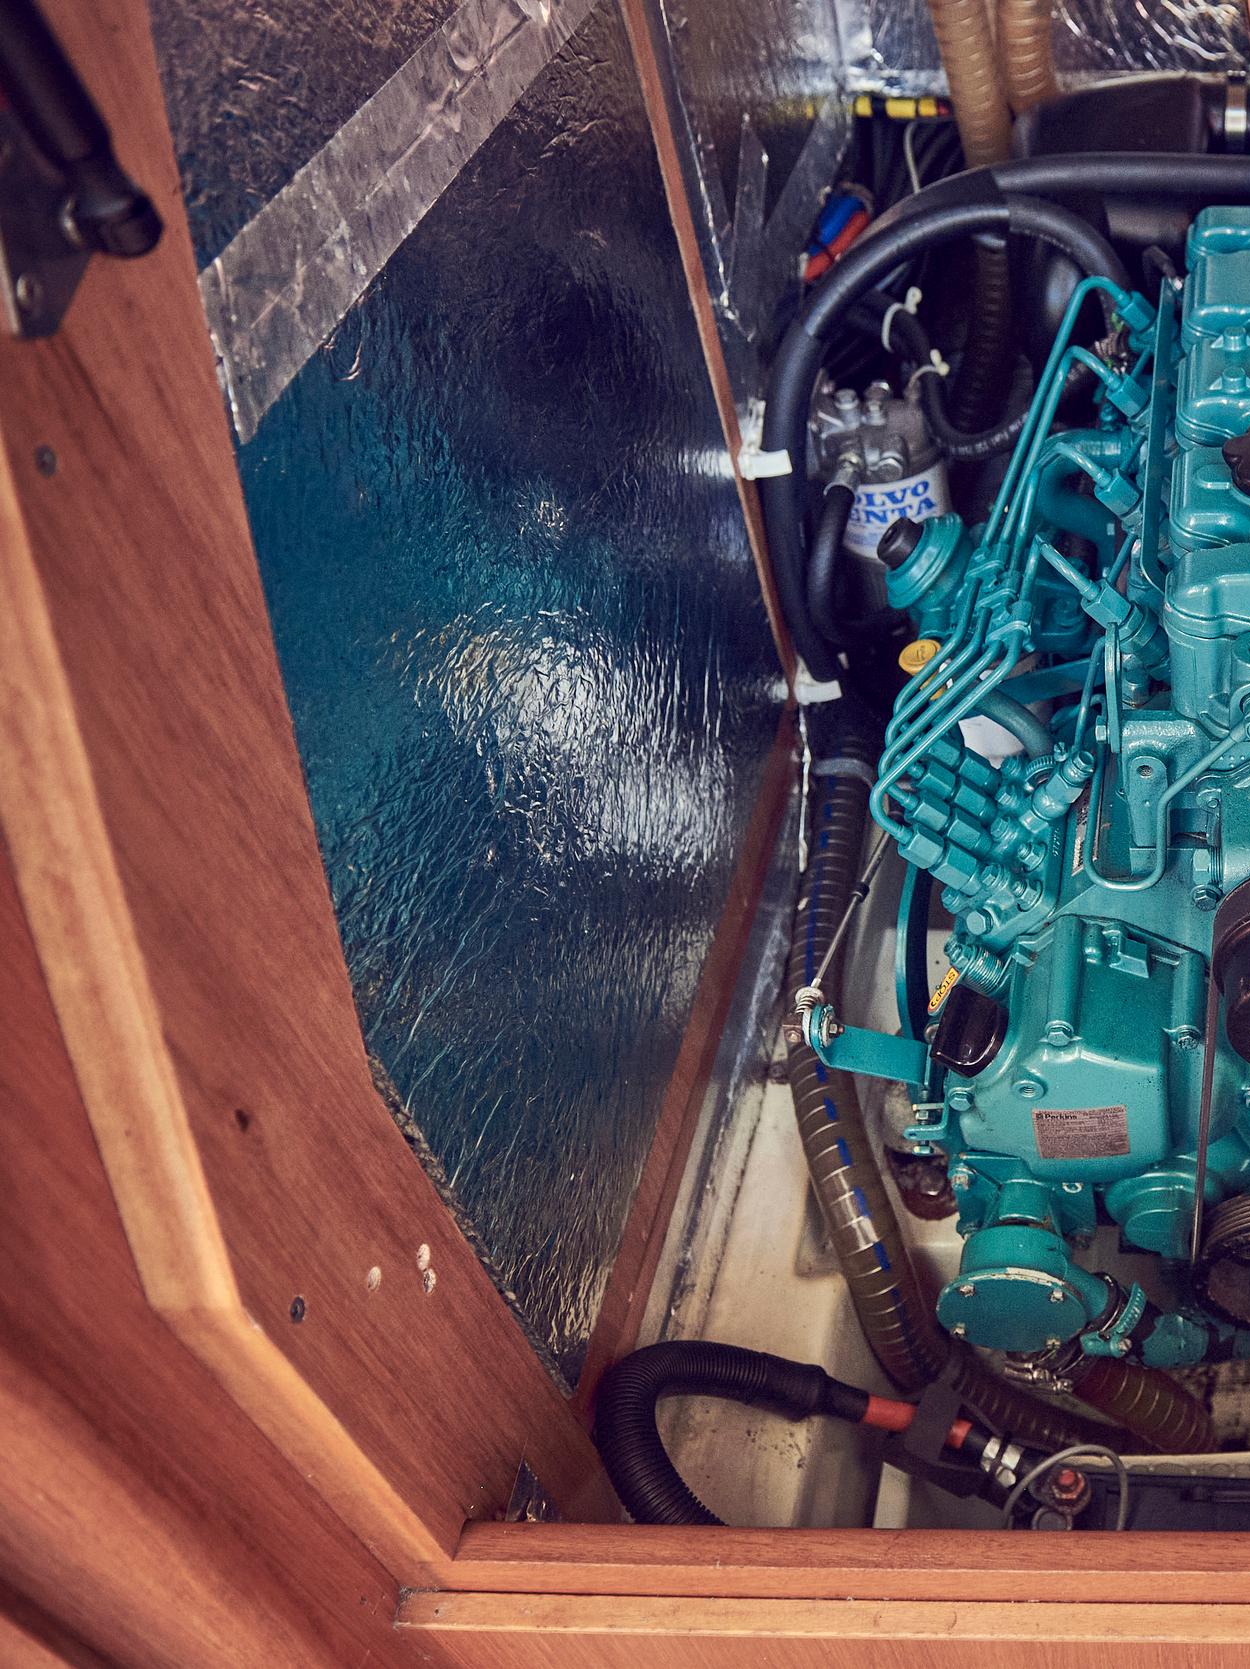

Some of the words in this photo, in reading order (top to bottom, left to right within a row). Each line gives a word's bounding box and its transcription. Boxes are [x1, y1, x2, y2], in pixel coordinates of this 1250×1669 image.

[854, 480, 929, 507] LVO
[848, 497, 938, 524] ENTA
[935, 970, 956, 1002] STOP
